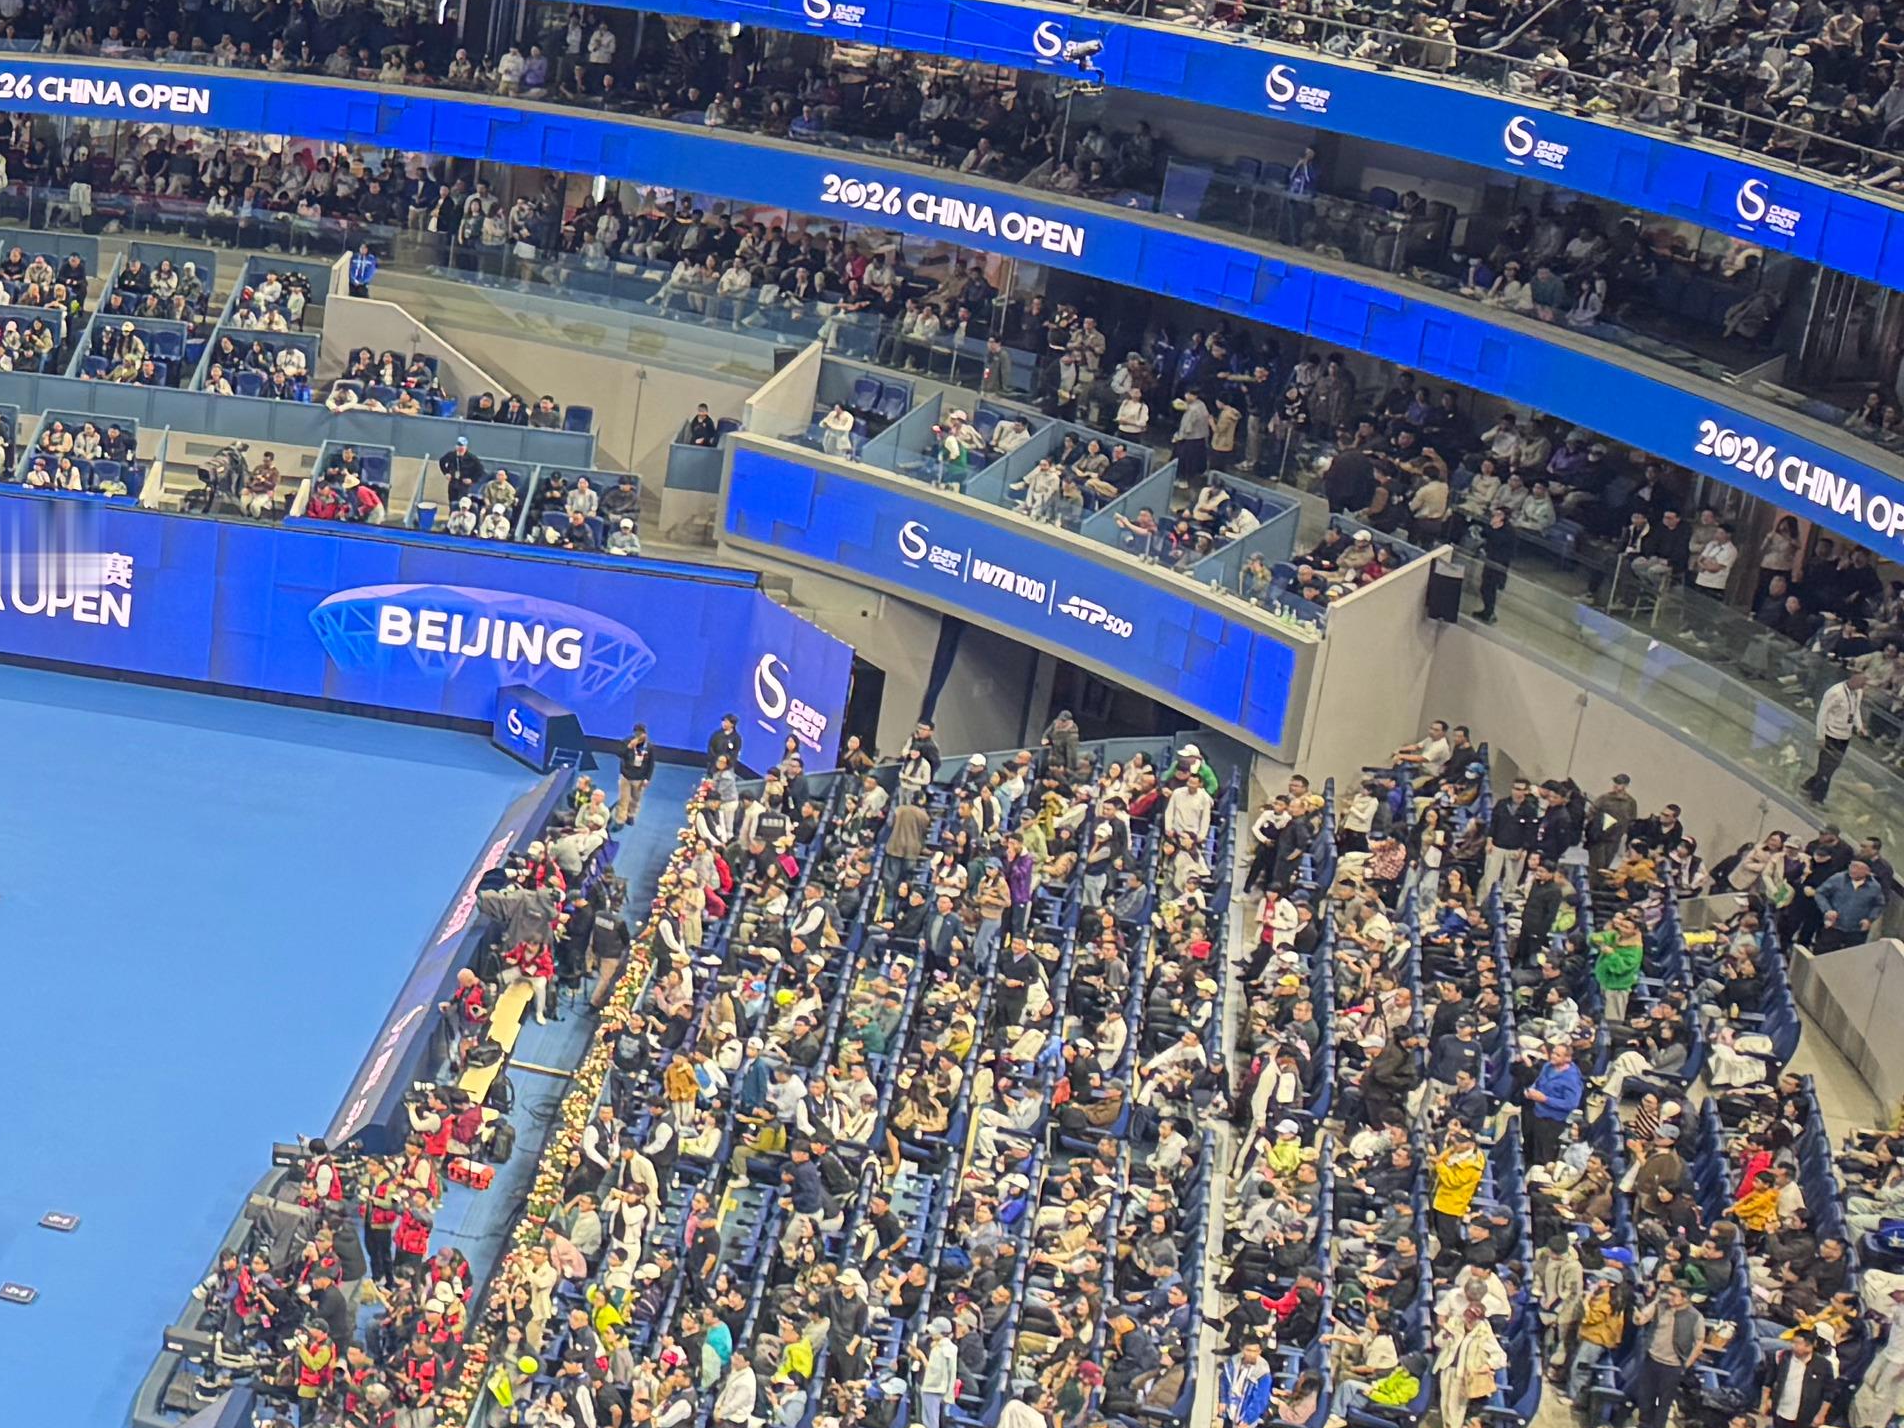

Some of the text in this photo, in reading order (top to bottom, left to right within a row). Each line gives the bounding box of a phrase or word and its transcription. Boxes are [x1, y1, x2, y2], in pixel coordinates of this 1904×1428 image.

[37, 75, 126, 108] CHINA
[128, 82, 210, 114] OPEN
[906, 191, 996, 237] CHINA
[1000, 211, 1085, 257] OPEN
[1778, 456, 1863, 523] CHINA
[378, 604, 584, 670] BEIJING
[1057, 595, 1133, 639] ATP 500
